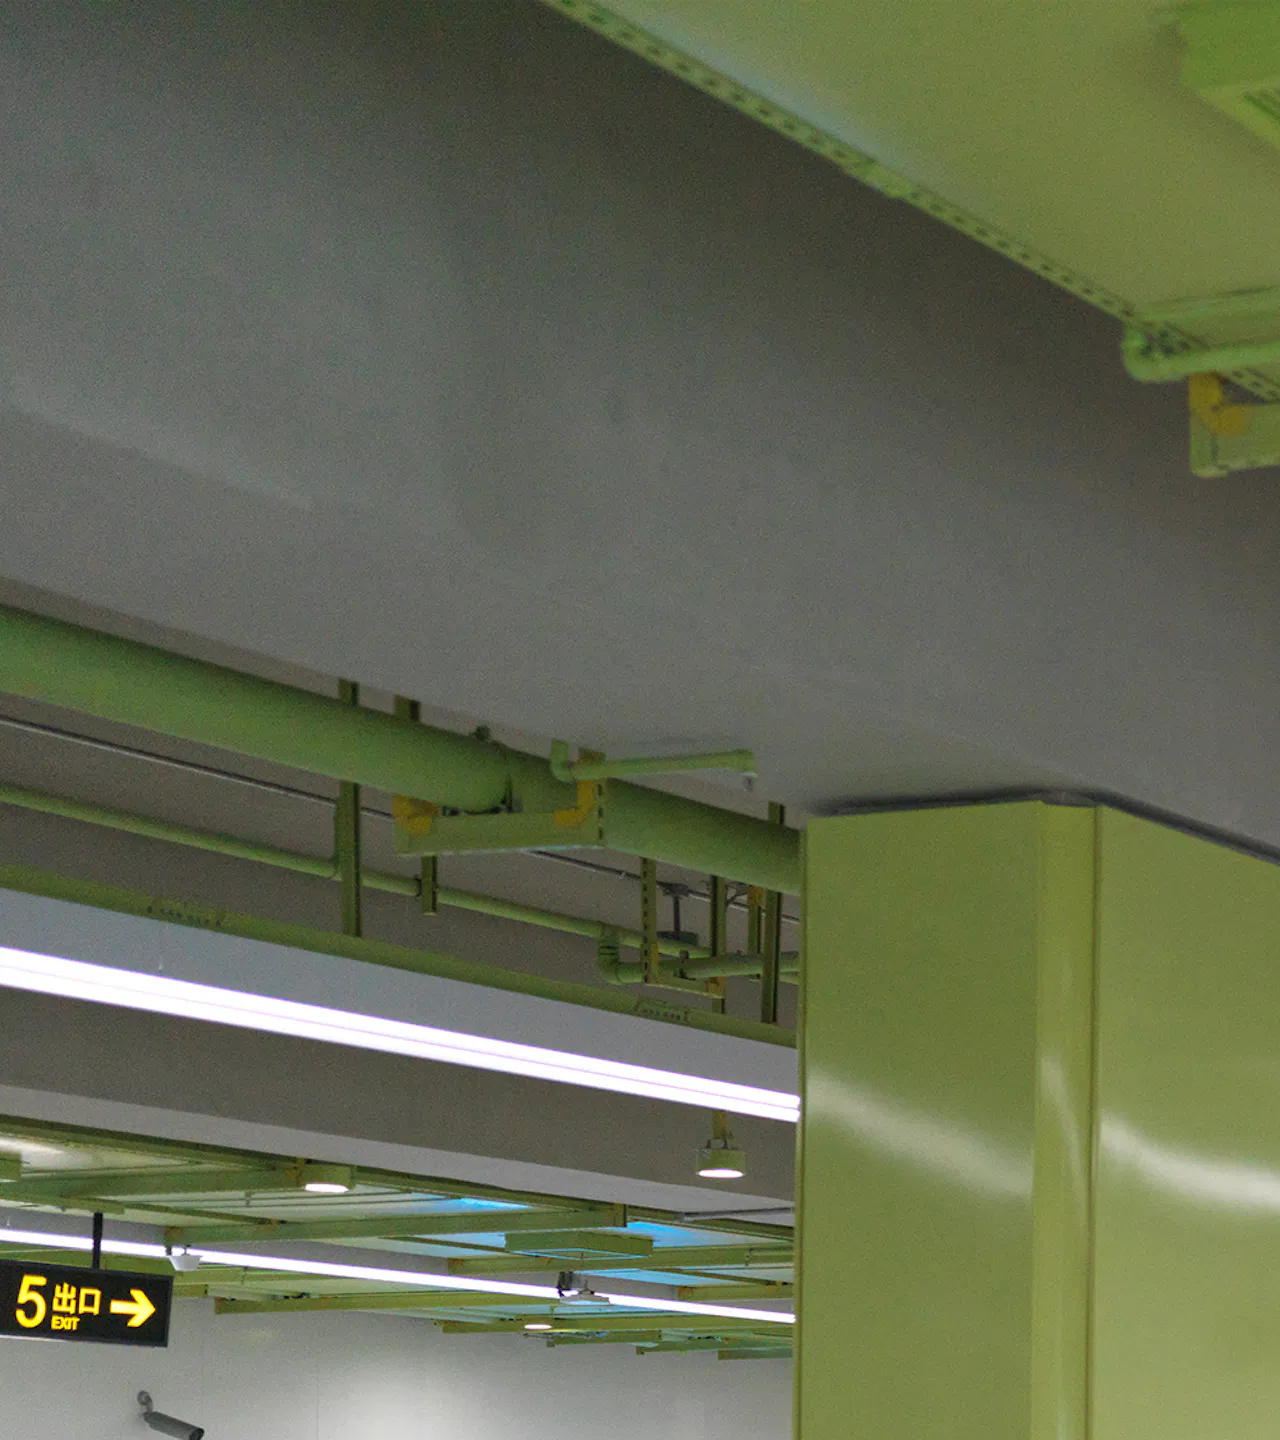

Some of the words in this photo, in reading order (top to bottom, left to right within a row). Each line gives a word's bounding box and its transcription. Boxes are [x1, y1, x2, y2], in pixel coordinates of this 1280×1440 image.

[15, 1274, 47, 1328] 5
[51, 1282, 102, 1316] 出口
[50, 1315, 80, 1331] EXIT
